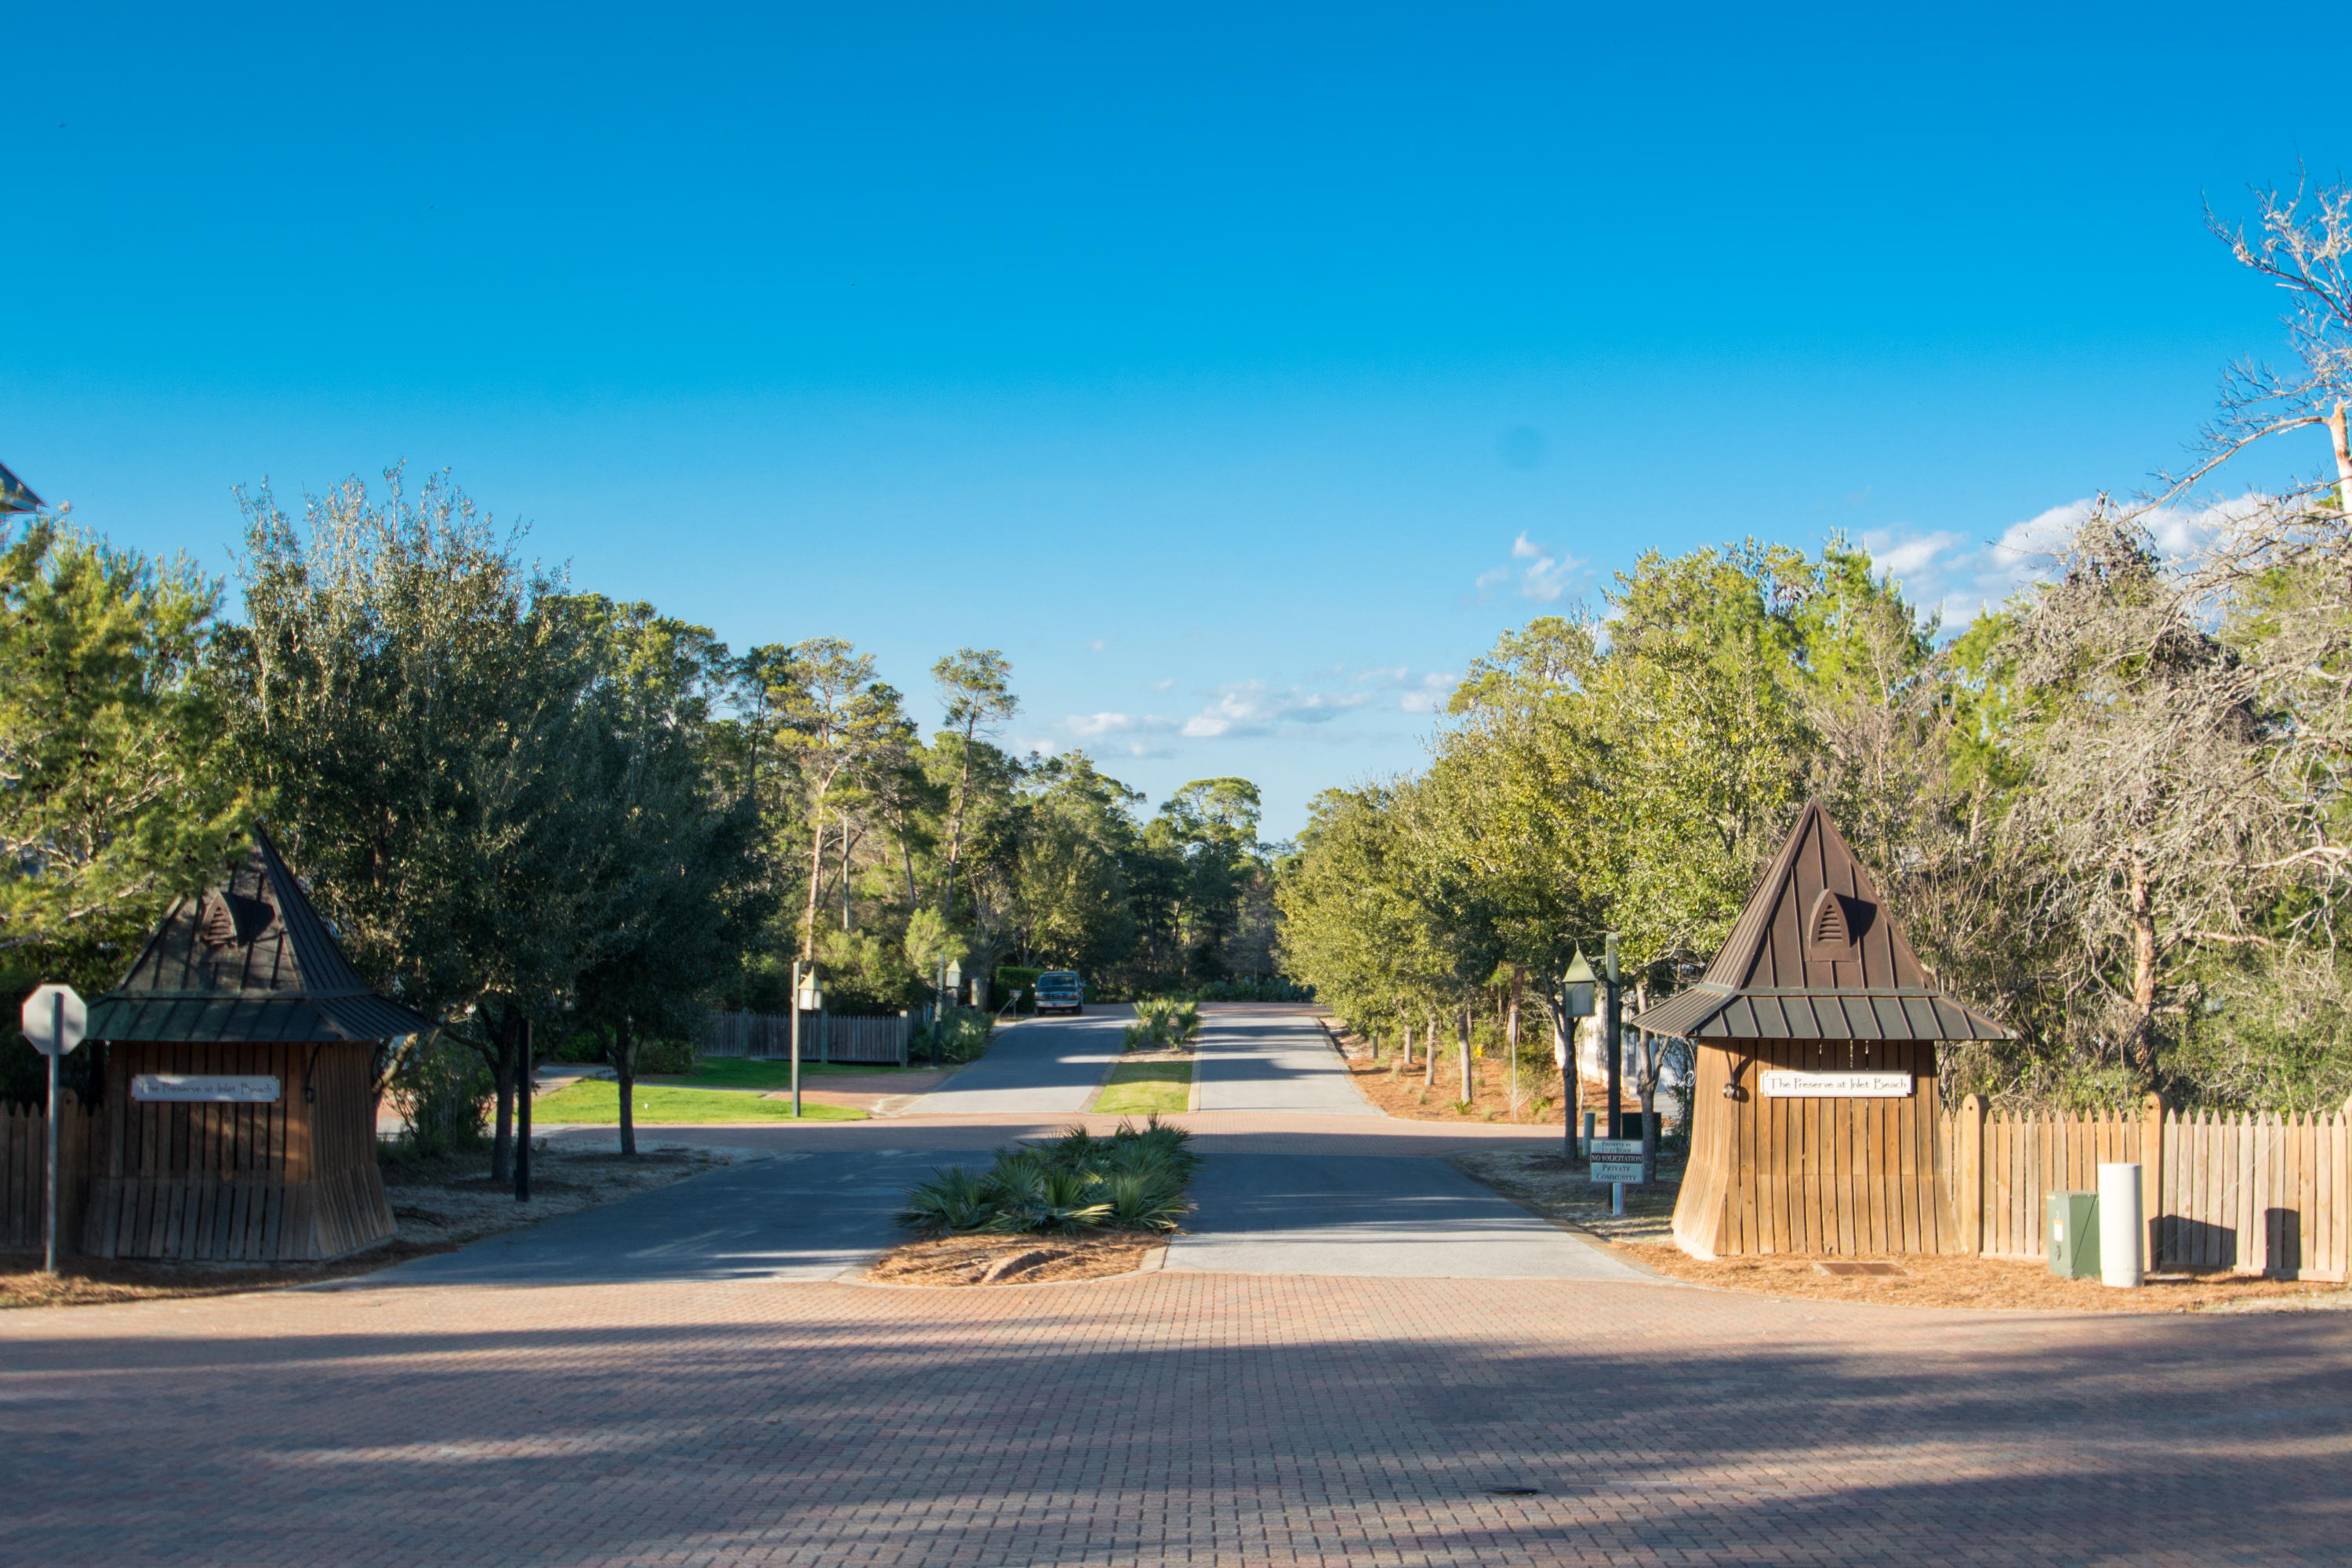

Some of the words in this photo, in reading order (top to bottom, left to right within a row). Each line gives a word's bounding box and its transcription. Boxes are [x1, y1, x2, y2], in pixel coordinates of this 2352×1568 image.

[241, 1083, 273, 1094] Beach
[1771, 1078, 1791, 1089] The
[1794, 1078, 1833, 1090] Preserve
[1850, 1078, 1870, 1090] Inlet
[1874, 1078, 1907, 1090] Beach
[1602, 1154, 1642, 1163] SOLICITATION
